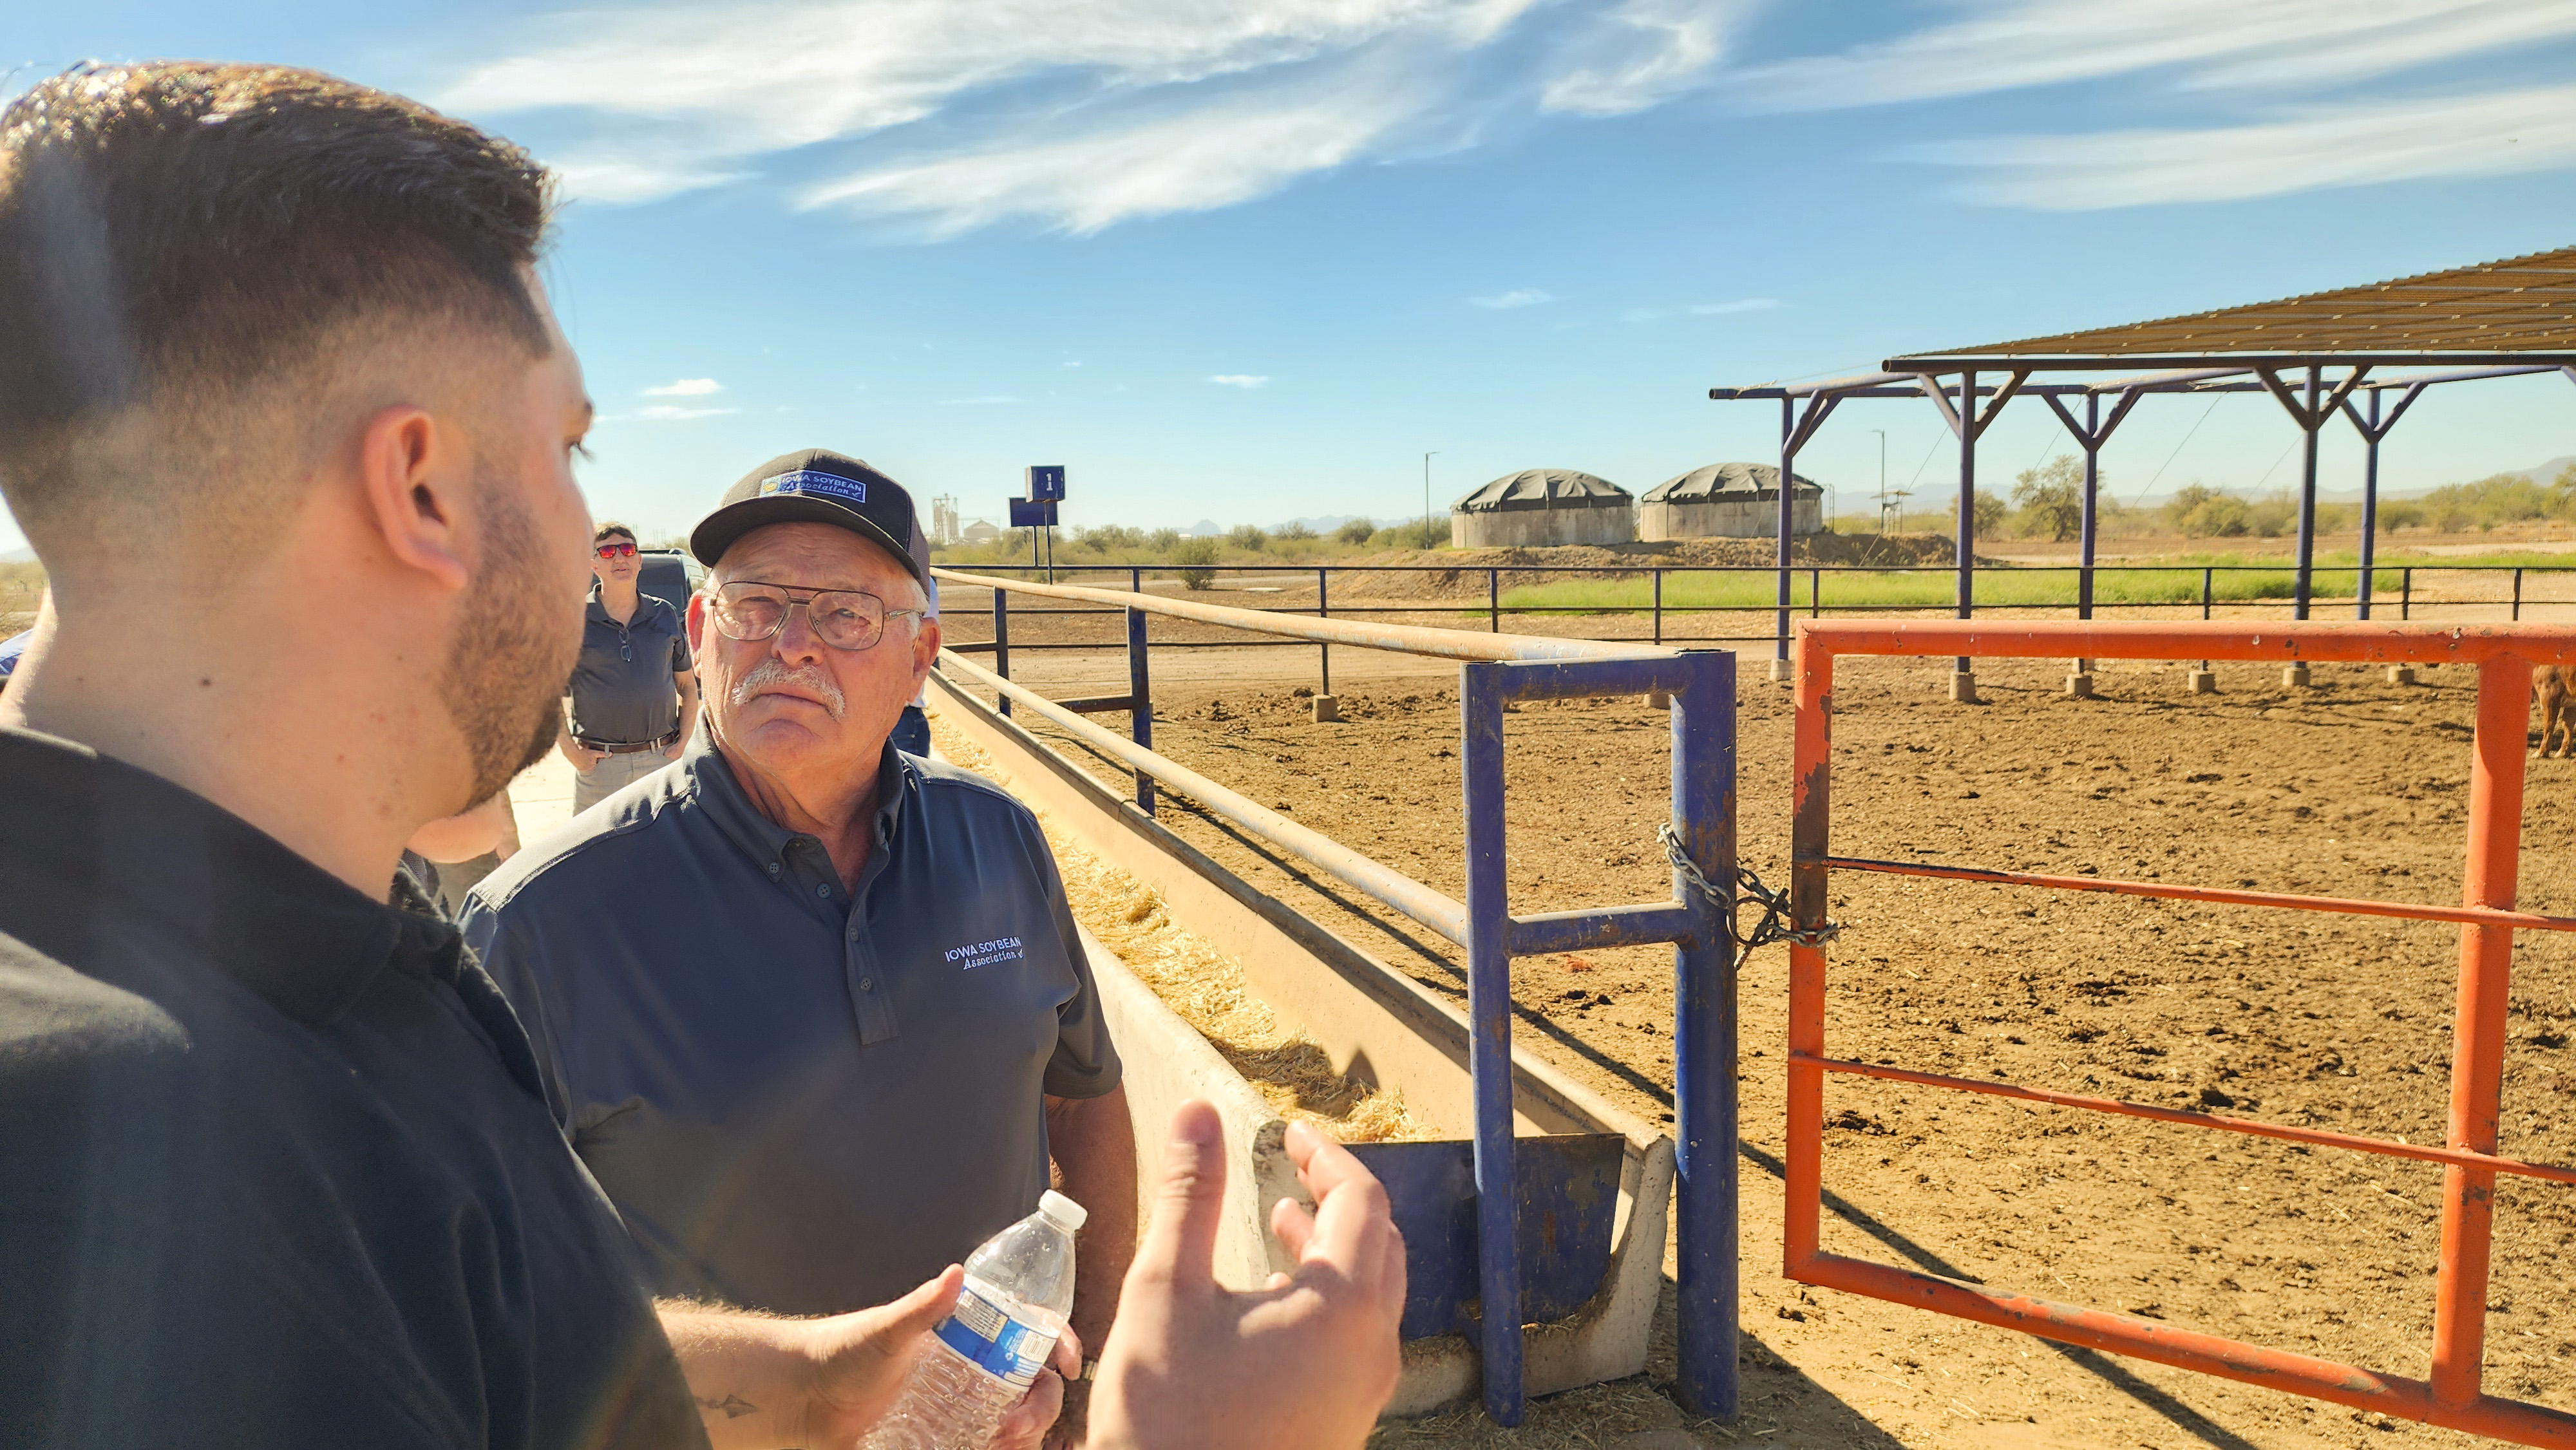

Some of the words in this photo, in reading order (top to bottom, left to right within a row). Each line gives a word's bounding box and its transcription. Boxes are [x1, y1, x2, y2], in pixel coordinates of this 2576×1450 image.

[782, 474, 810, 483] IOWA
[813, 476, 862, 491] SOYBEAN
[785, 482, 849, 495] Association
[1046, 473, 1053, 491] 1
[944, 944, 978, 963] IOWA
[978, 936, 1022, 953] SOYBEAN
[963, 950, 1016, 970] Association
